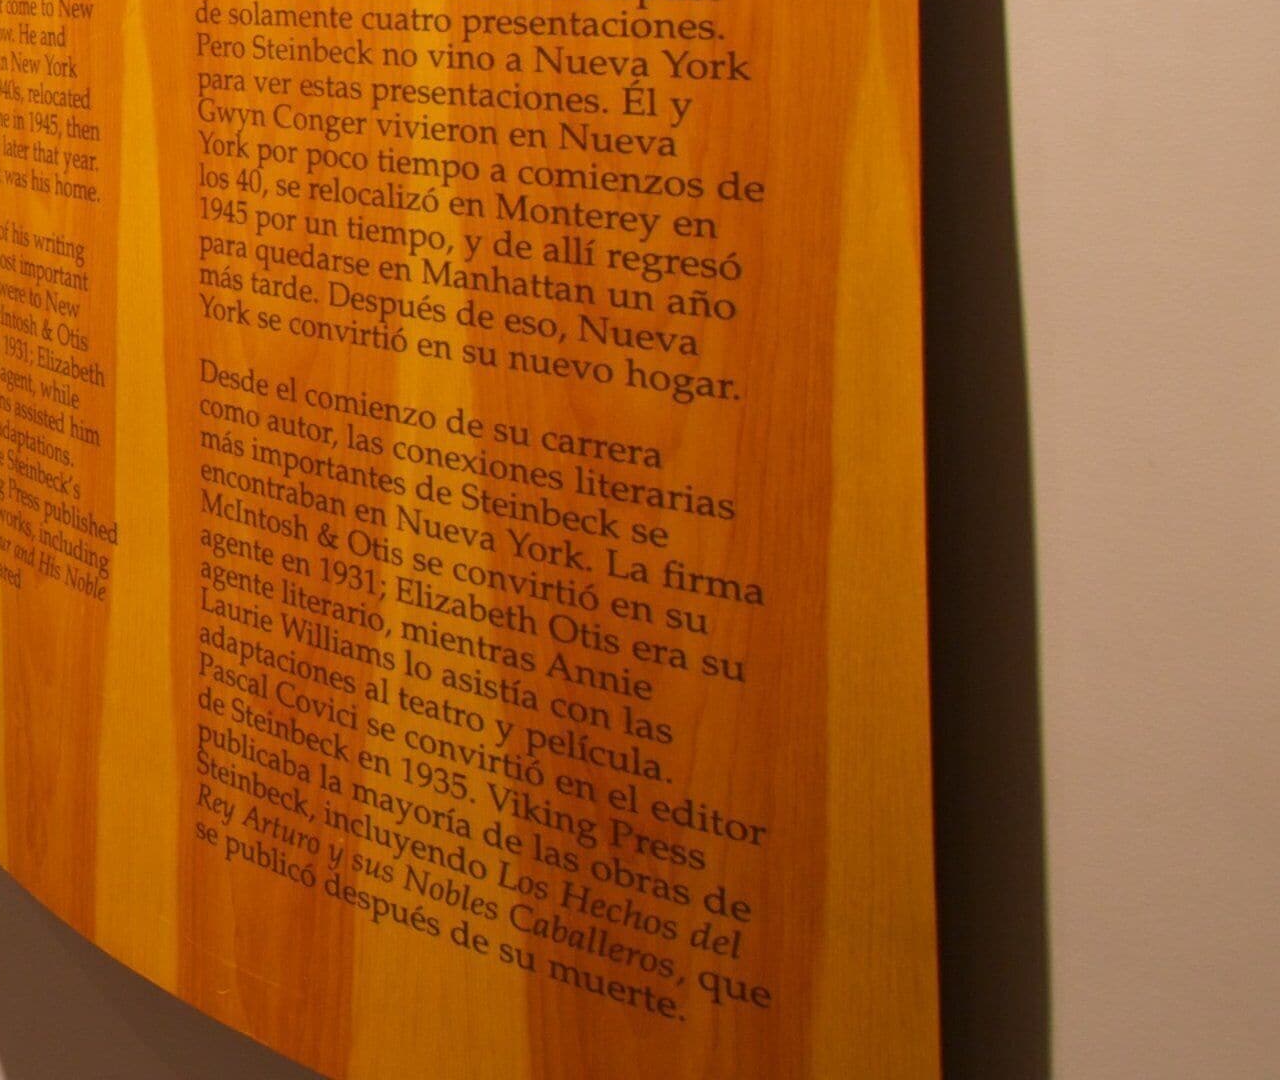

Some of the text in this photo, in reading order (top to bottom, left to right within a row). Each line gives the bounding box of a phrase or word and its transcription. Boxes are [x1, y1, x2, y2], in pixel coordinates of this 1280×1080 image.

[19, 22, 68, 48] He and
[195, 0, 724, 40] de solamente cuatro presentaciones.
[10, 51, 78, 79] New York
[4, 170, 100, 202] was his home.
[200, 358, 662, 468] Desde el comienzo de su carrera
[195, 822, 684, 1021] se publicó después de su muerte.
